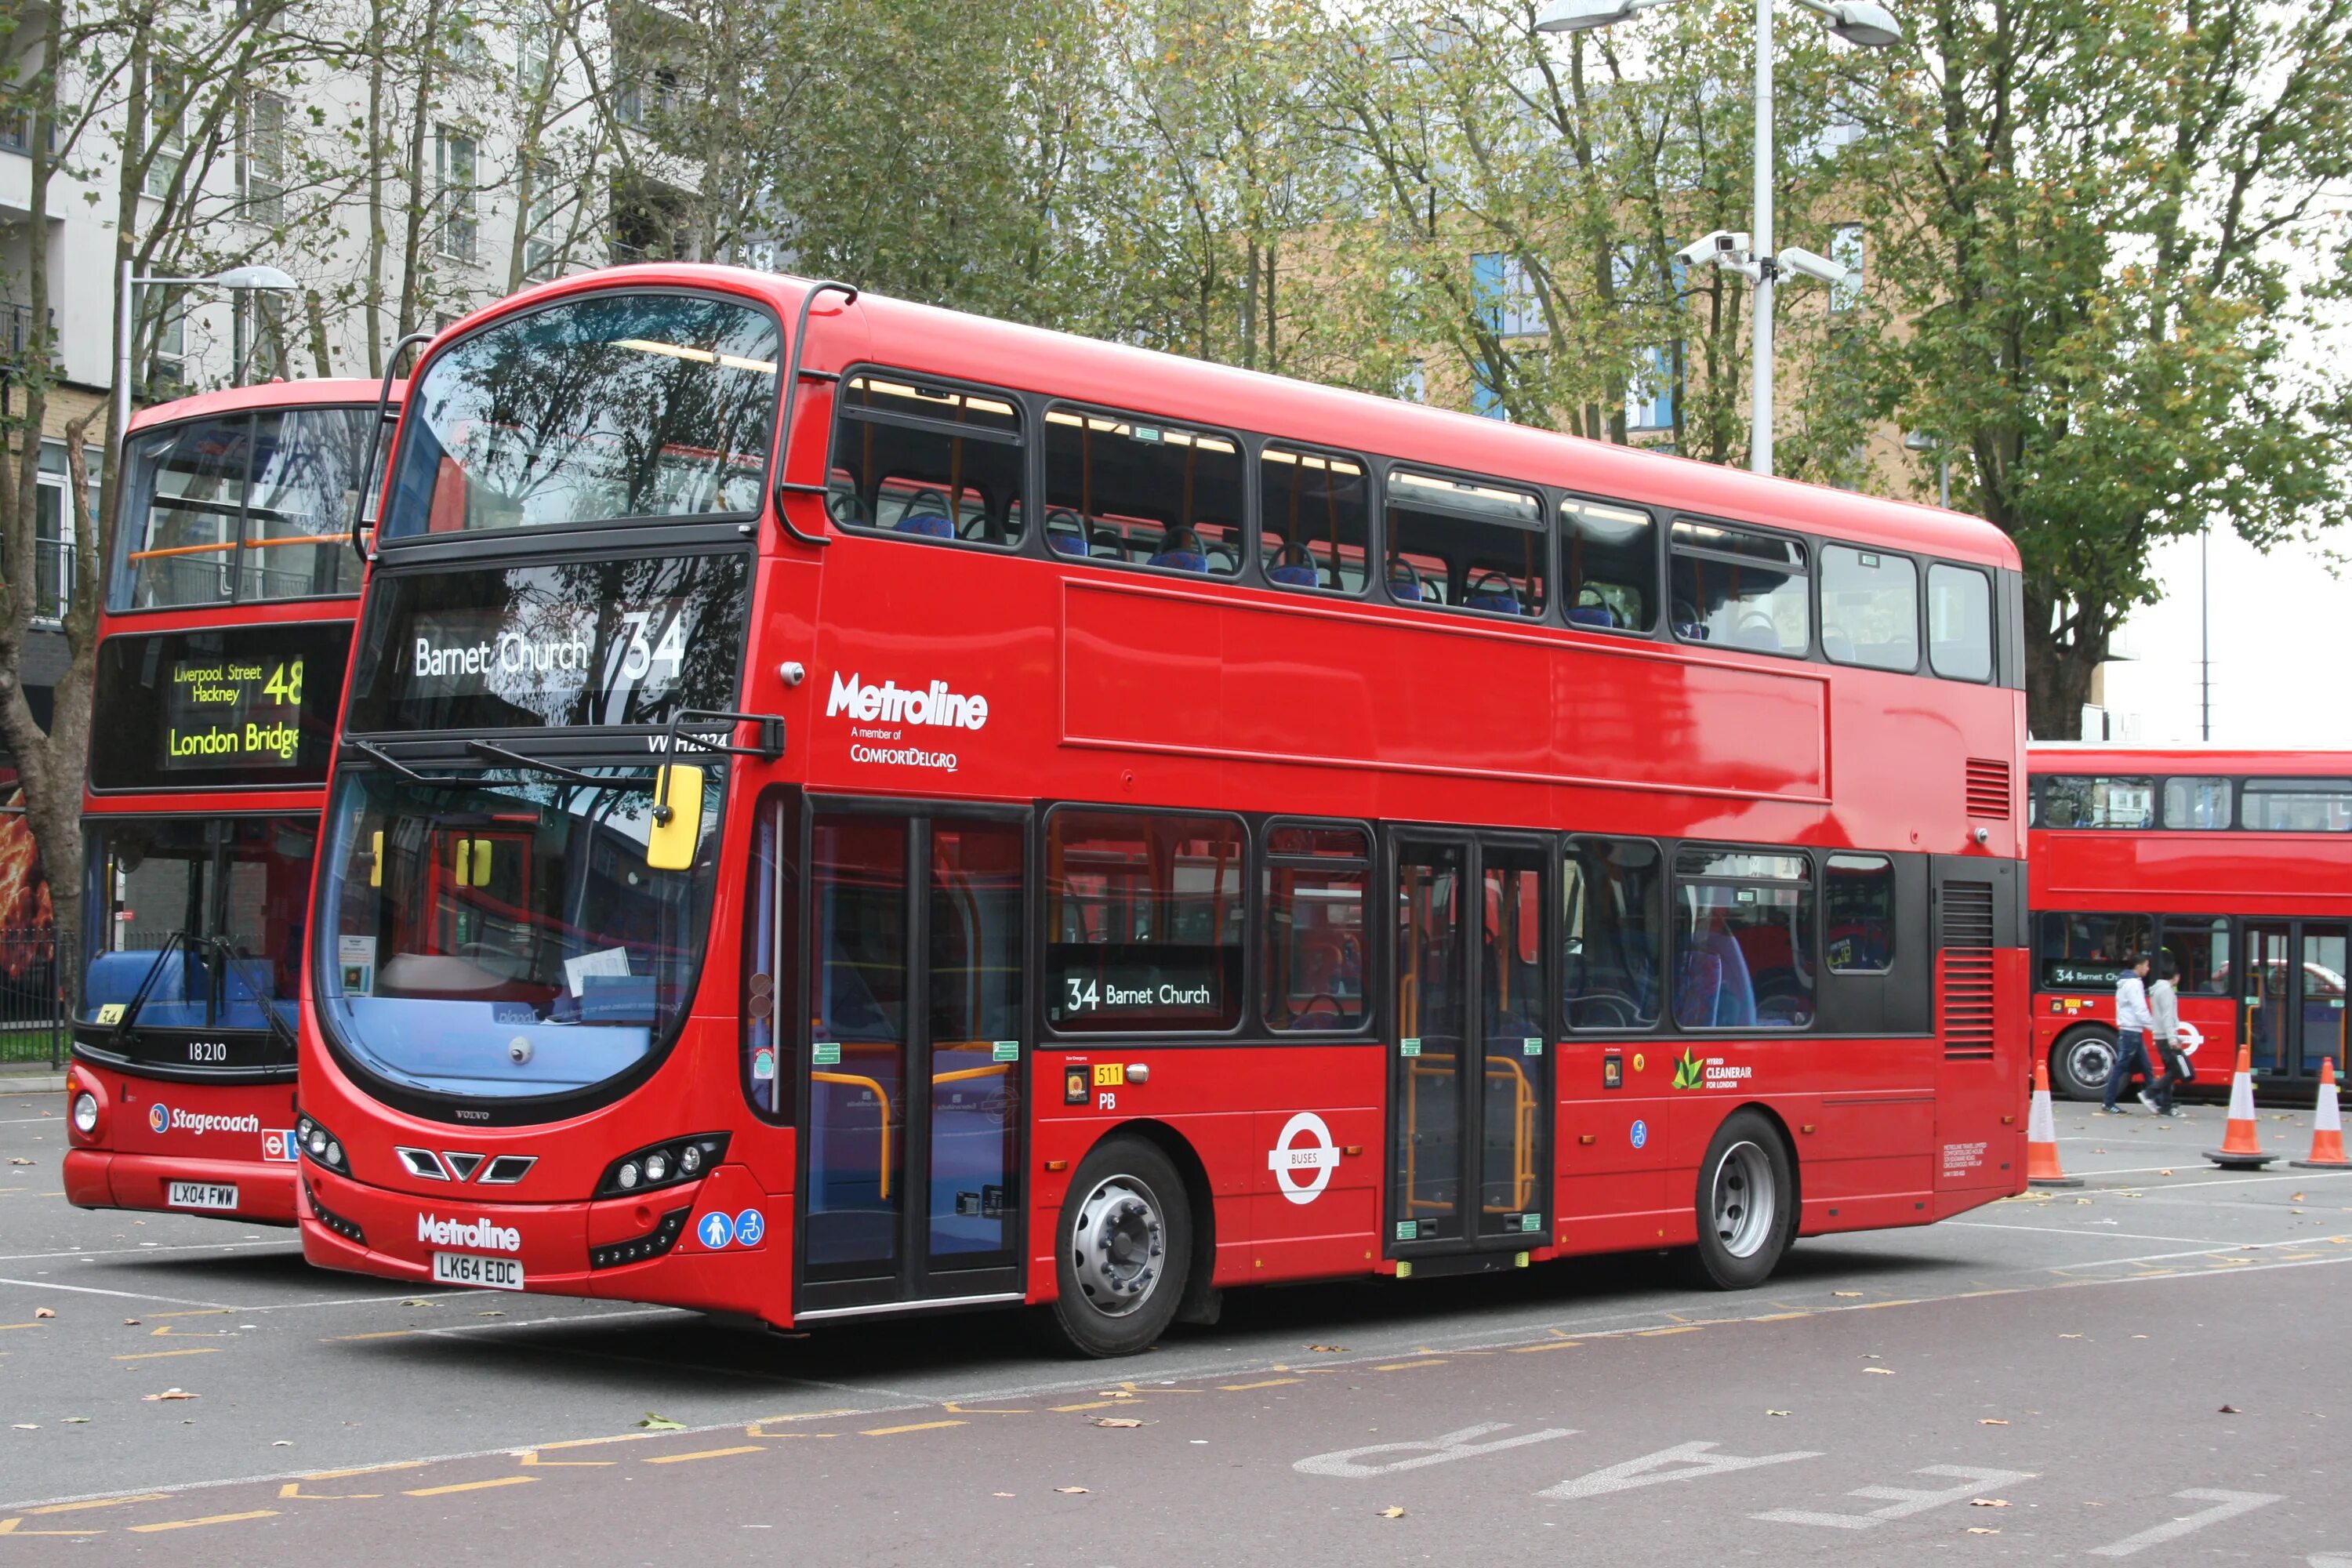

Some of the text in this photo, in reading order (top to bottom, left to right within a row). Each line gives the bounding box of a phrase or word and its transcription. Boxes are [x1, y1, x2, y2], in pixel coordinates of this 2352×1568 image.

[416, 630, 588, 677] Barnet Church
[623, 610, 686, 680] 34
[174, 664, 262, 686] Liverpool Street
[263, 660, 303, 705] 48
[193, 684, 241, 706] Hackney
[826, 670, 988, 730] Metroline
[171, 721, 299, 759] London Bridge
[851, 727, 902, 740] A member of
[2056, 969, 2074, 982] 34
[2077, 972, 2103, 981] Barnet
[1068, 978, 1210, 1011] 34 Barnet Church
[189, 1043, 227, 1061] 18210
[1098, 1066, 1120, 1083] 511
[1099, 1093, 1116, 1109] PB
[172, 1108, 259, 1134] Stagecoach
[456, 1109, 490, 1120] VOLVO
[1291, 1152, 1317, 1164] BUSES
[174, 1185, 234, 1206] LX04 FWW
[419, 1212, 521, 1251] Metroline
[441, 1256, 516, 1284] LK64 EDC
[1292, 1420, 2352, 1568] LEAR
